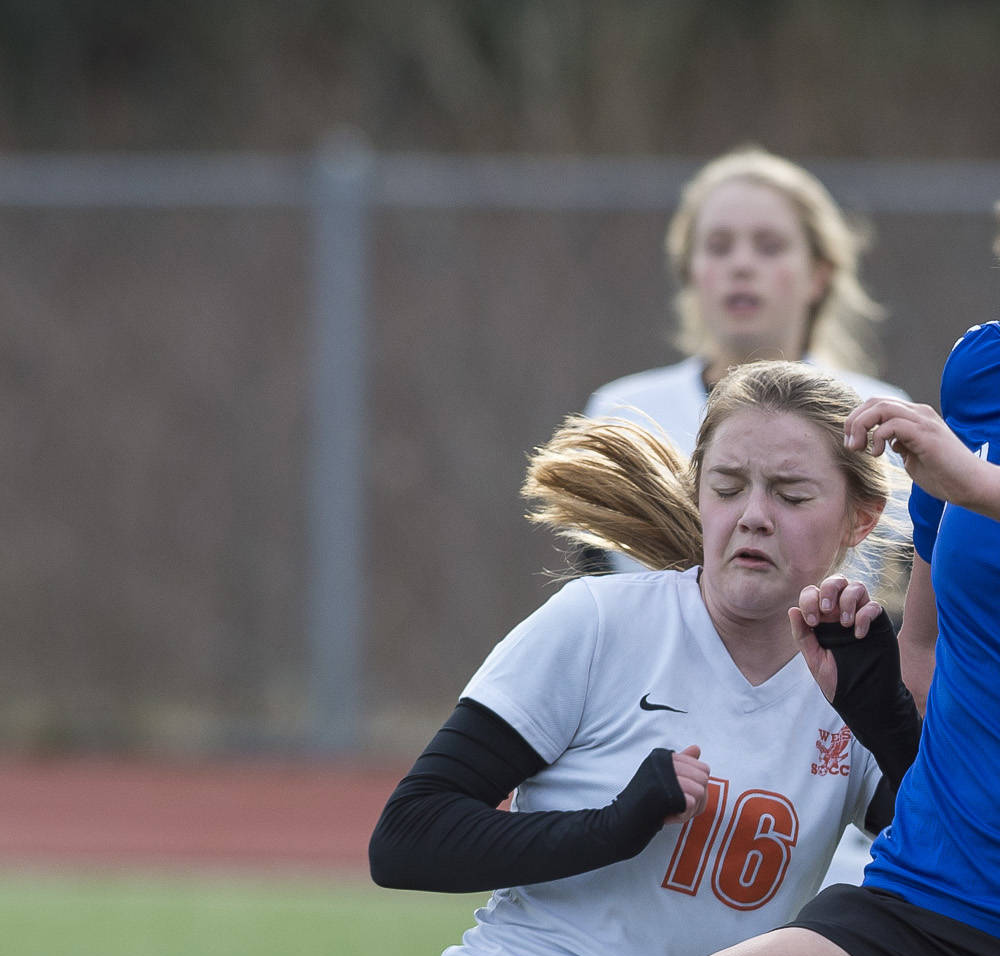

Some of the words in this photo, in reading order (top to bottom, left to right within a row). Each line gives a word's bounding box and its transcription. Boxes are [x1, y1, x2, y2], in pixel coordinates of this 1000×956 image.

[818, 727, 852, 742] WES
[811, 762, 851, 776] SOCC
[661, 776, 799, 911] 16
